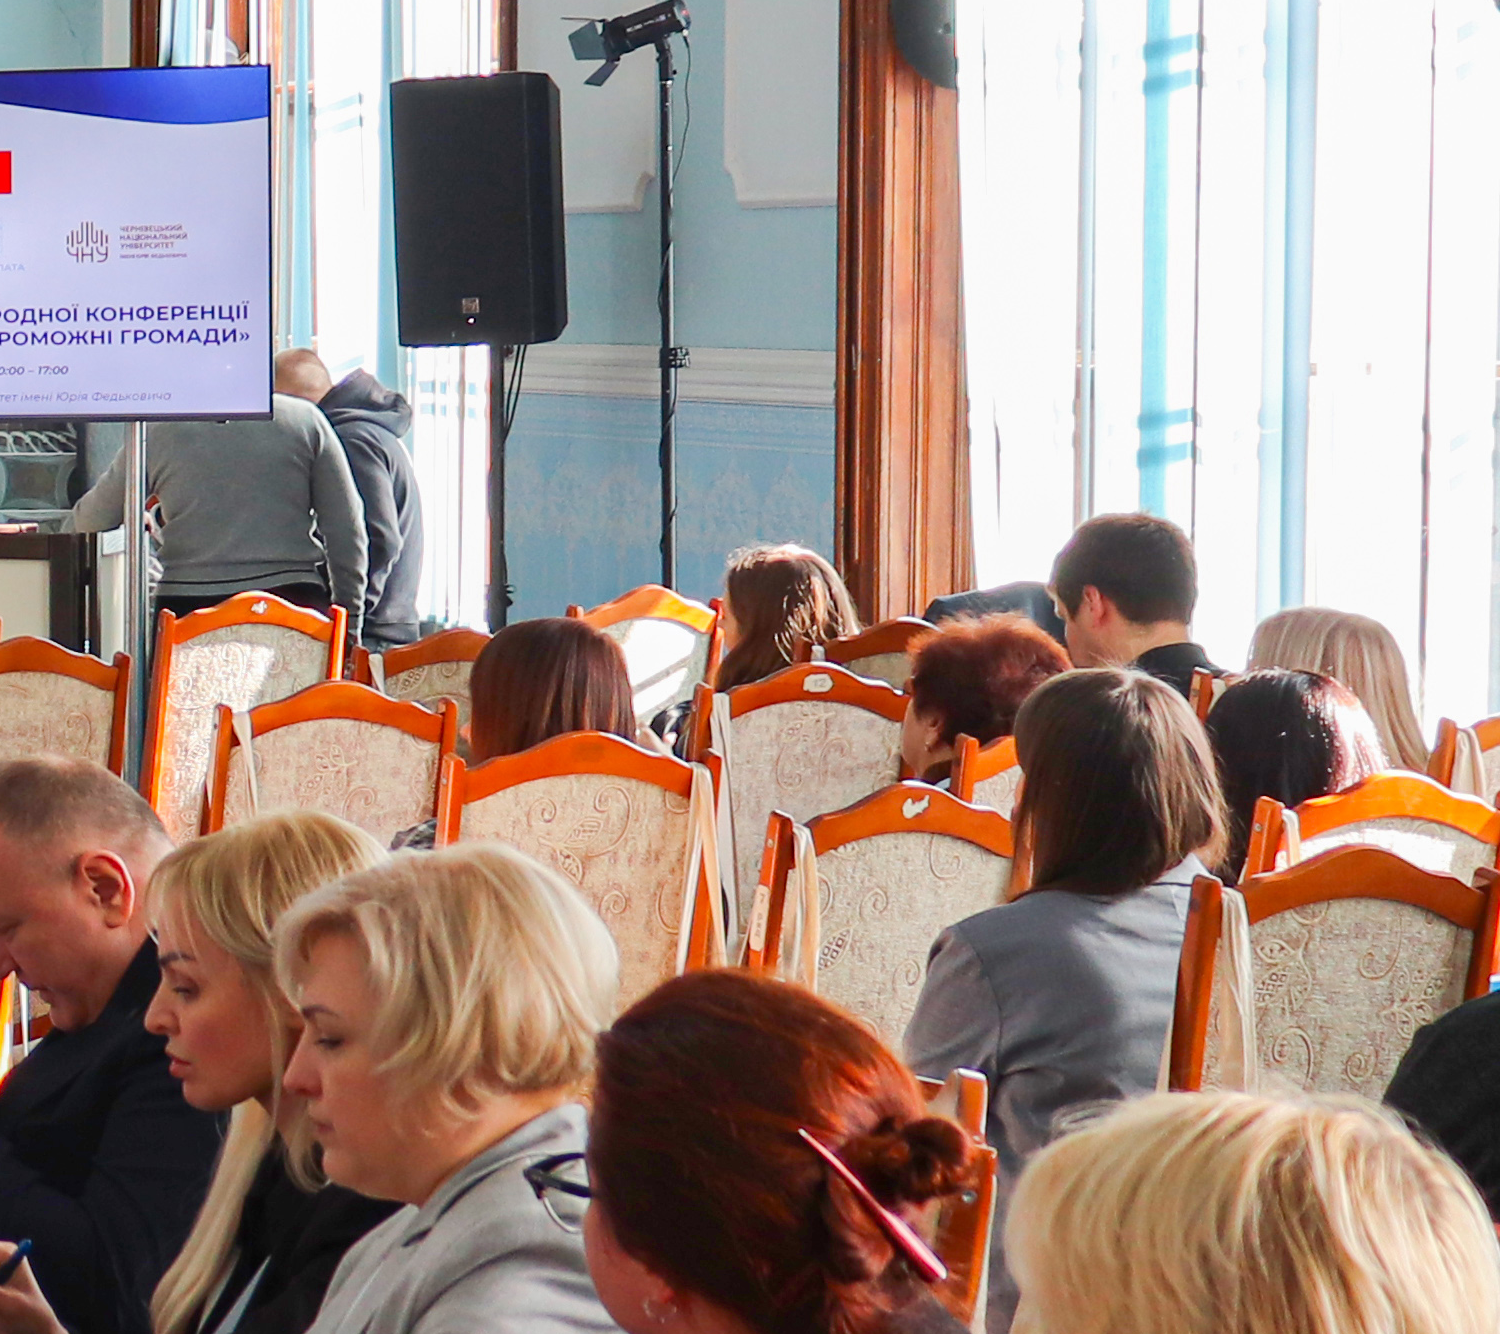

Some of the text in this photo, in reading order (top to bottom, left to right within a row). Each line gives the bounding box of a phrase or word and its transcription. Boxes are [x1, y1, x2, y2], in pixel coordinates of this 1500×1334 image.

[87, 301, 249, 322] КОНФЕРЕНЦІЇ
[121, 328, 250, 347] ГРОМАДИ»
[37, 366, 69, 375] 17:00
[20, 392, 53, 402] імені
[56, 392, 88, 403] Юрія
[90, 391, 172, 403] Федьковича
